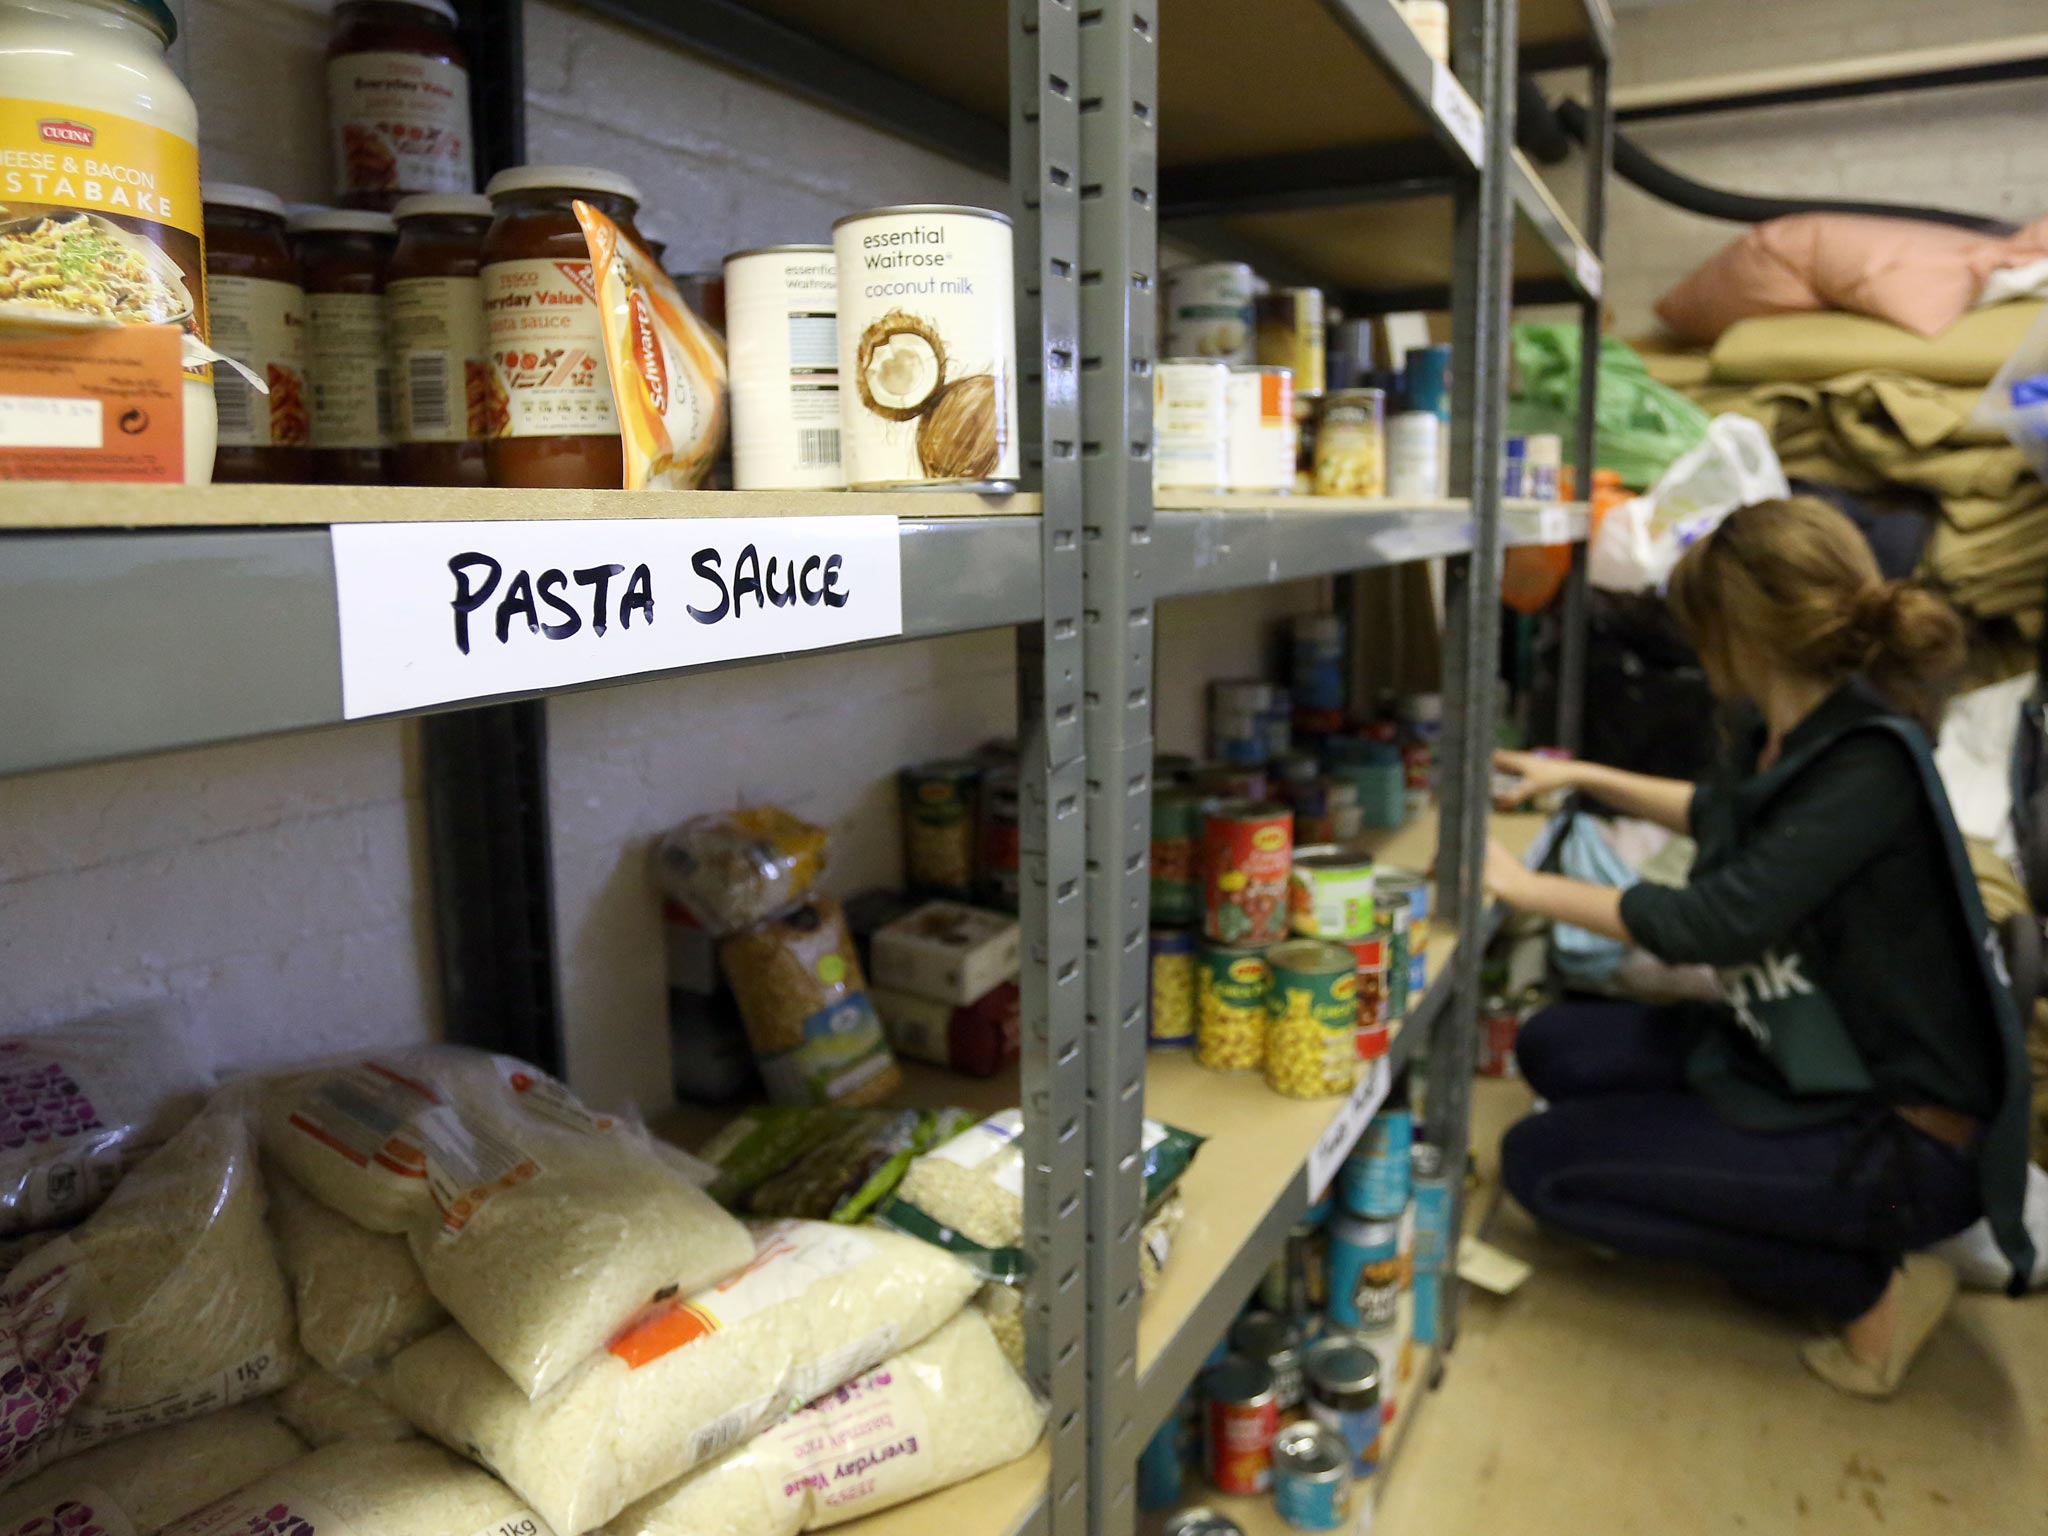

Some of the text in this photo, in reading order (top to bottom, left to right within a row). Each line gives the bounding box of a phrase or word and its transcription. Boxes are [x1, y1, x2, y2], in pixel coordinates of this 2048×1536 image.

[42, 127, 91, 143] CUCINA
[0, 150, 155, 190] EESE & BACON
[863, 226, 944, 249] essential
[864, 251, 944, 270] Waitrose
[534, 290, 584, 305] Value
[865, 277, 974, 298] coconut milk
[520, 316, 571, 329] sauce
[636, 300, 667, 411] Schwartz
[448, 543, 850, 656] PASTA SAUCE
[833, 1436, 918, 1480] Everyday
